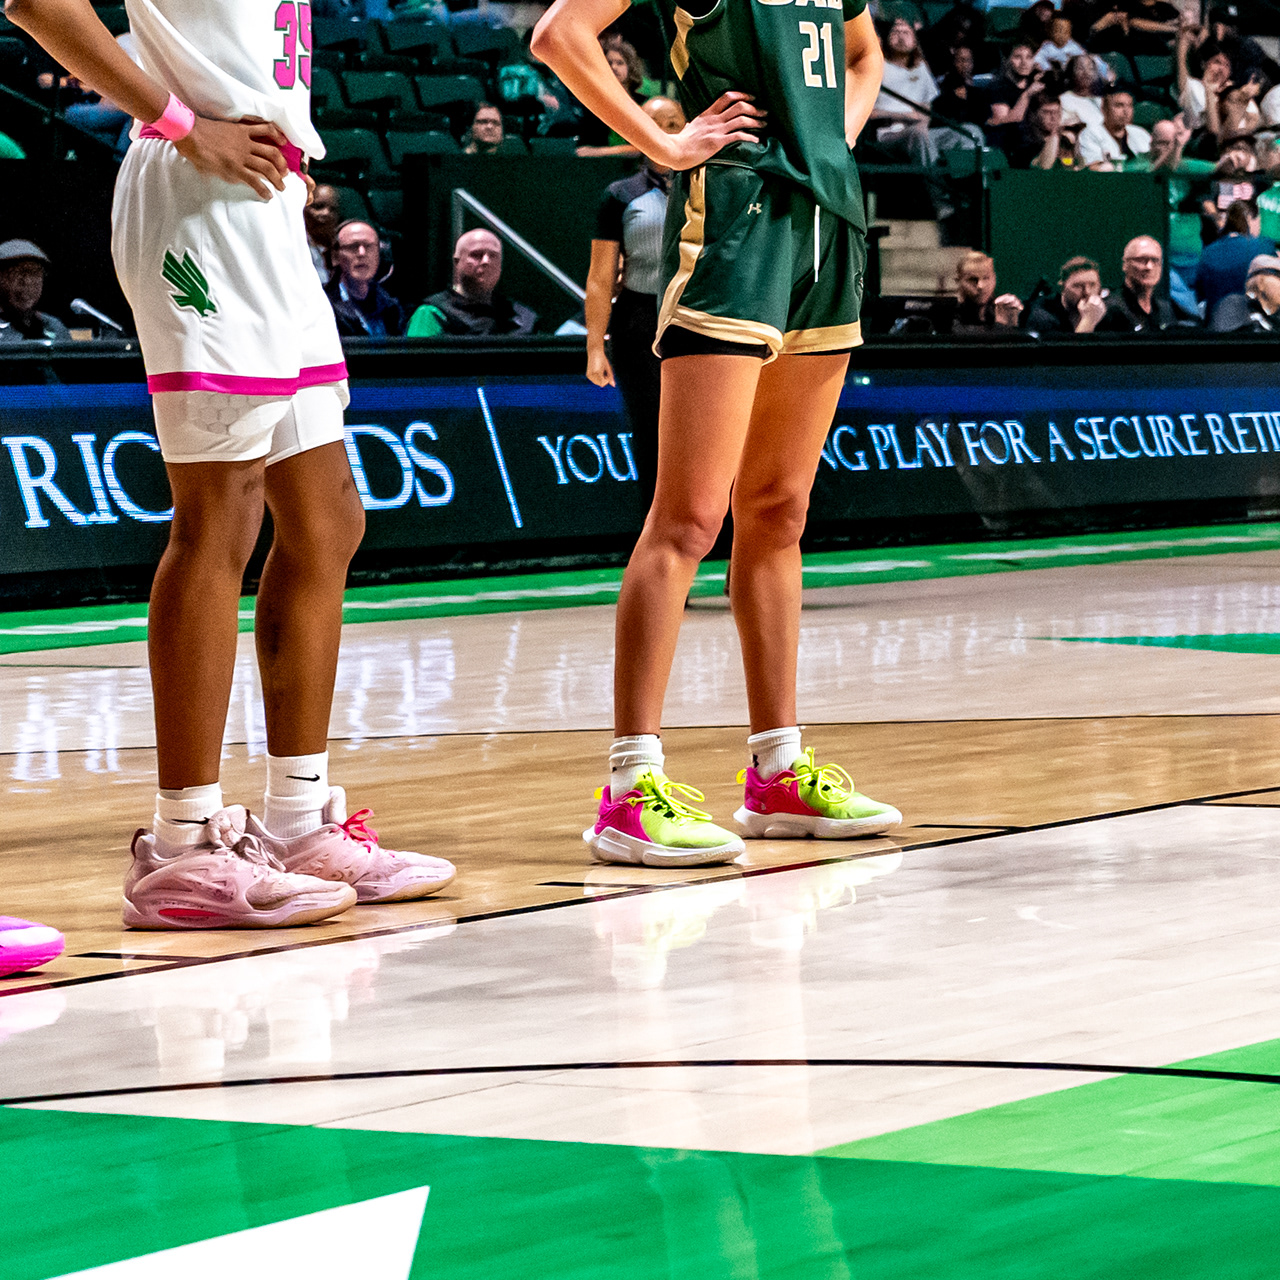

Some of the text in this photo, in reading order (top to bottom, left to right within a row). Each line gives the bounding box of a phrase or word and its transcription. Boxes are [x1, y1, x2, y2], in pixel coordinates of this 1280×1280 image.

[798, 20, 837, 89] 21
[866, 422, 955, 470] PLAY
[958, 420, 1042, 466] FOR
[1049, 421, 1076, 463] A
[1074, 413, 1209, 461] SECURE
